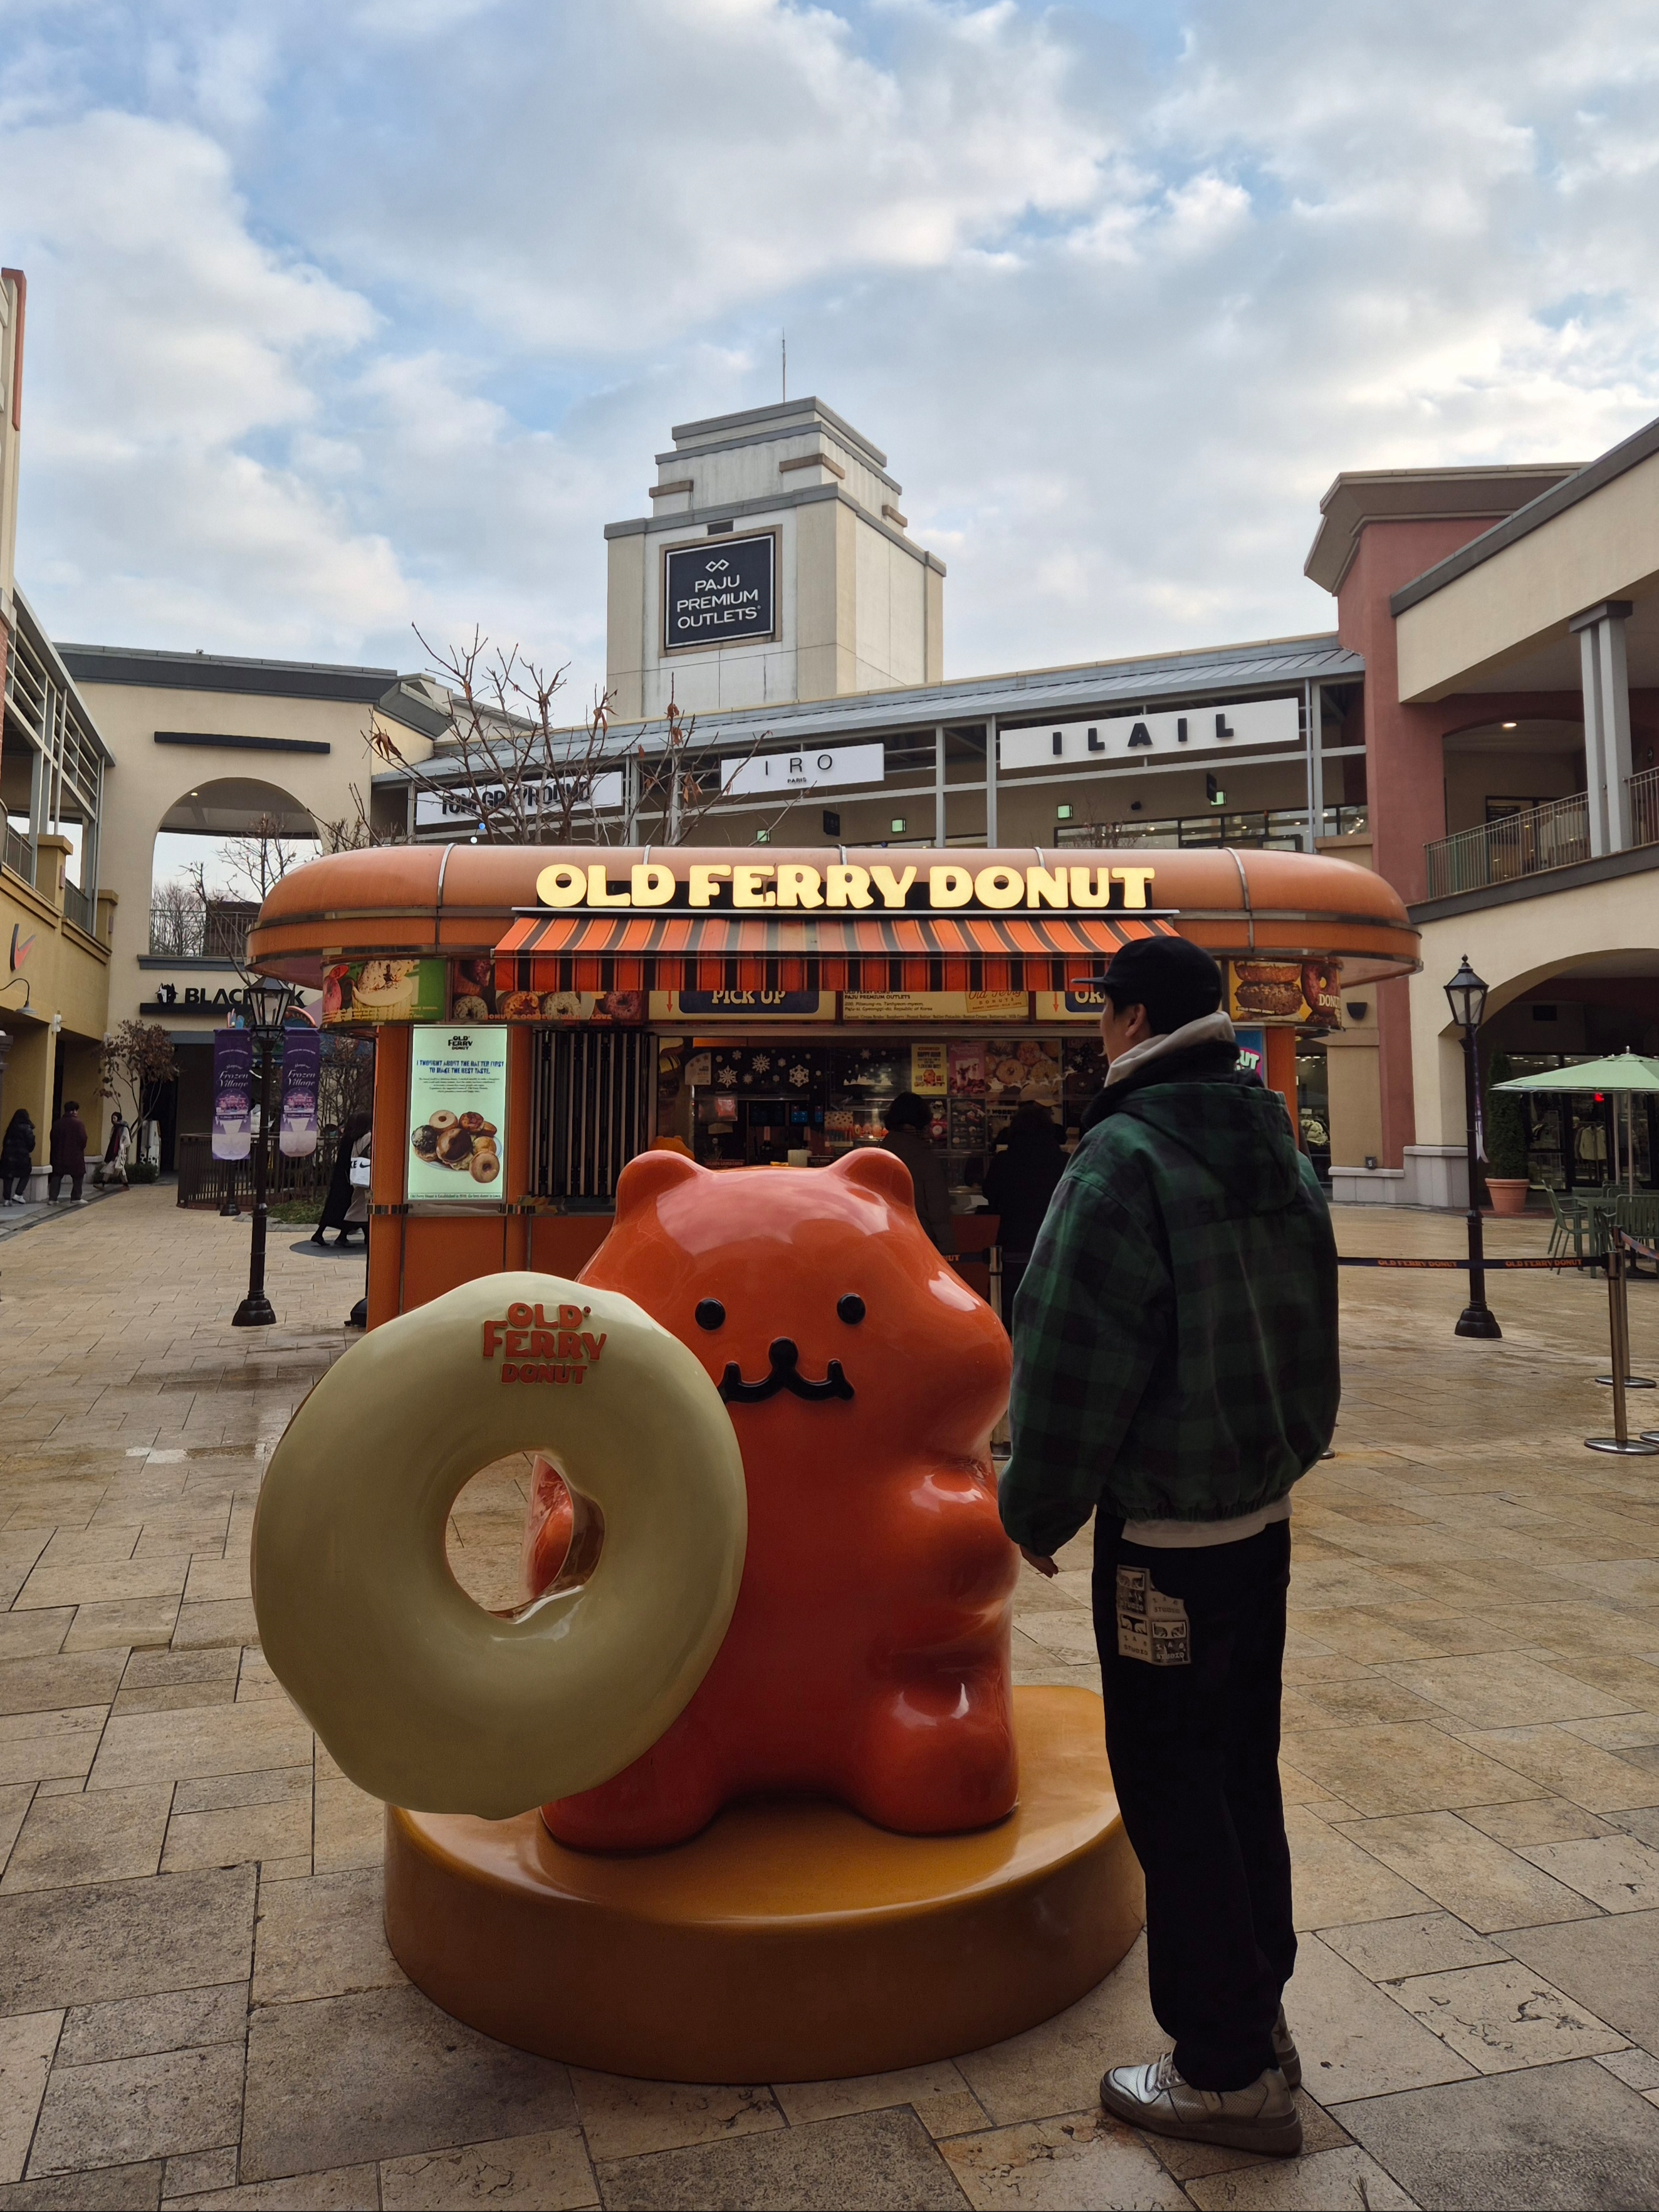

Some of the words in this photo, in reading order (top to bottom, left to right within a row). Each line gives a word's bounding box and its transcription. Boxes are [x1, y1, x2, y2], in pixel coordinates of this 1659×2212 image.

[695, 574, 740, 593] PAJU
[677, 588, 759, 613] PREMIUM
[678, 607, 758, 629] OUTLETS
[1052, 713, 1234, 755] ILAIL
[765, 754, 833, 776] IRO
[535, 863, 676, 908] OLD
[688, 863, 918, 909] FERRY
[929, 865, 1155, 909] DONUT
[711, 990, 755, 1004] PICK
[760, 990, 786, 1004] UP
[219, 1070, 248, 1079] Frozen
[219, 1079, 248, 1089] Village
[287, 1069, 315, 1078] Frozen
[288, 1078, 315, 1088] Village
[507, 1302, 583, 1329] OLD
[483, 1320, 607, 1361] FERRY
[501, 1362, 588, 1385] DONUT
[1124, 1644, 1148, 1656] STUDIO
